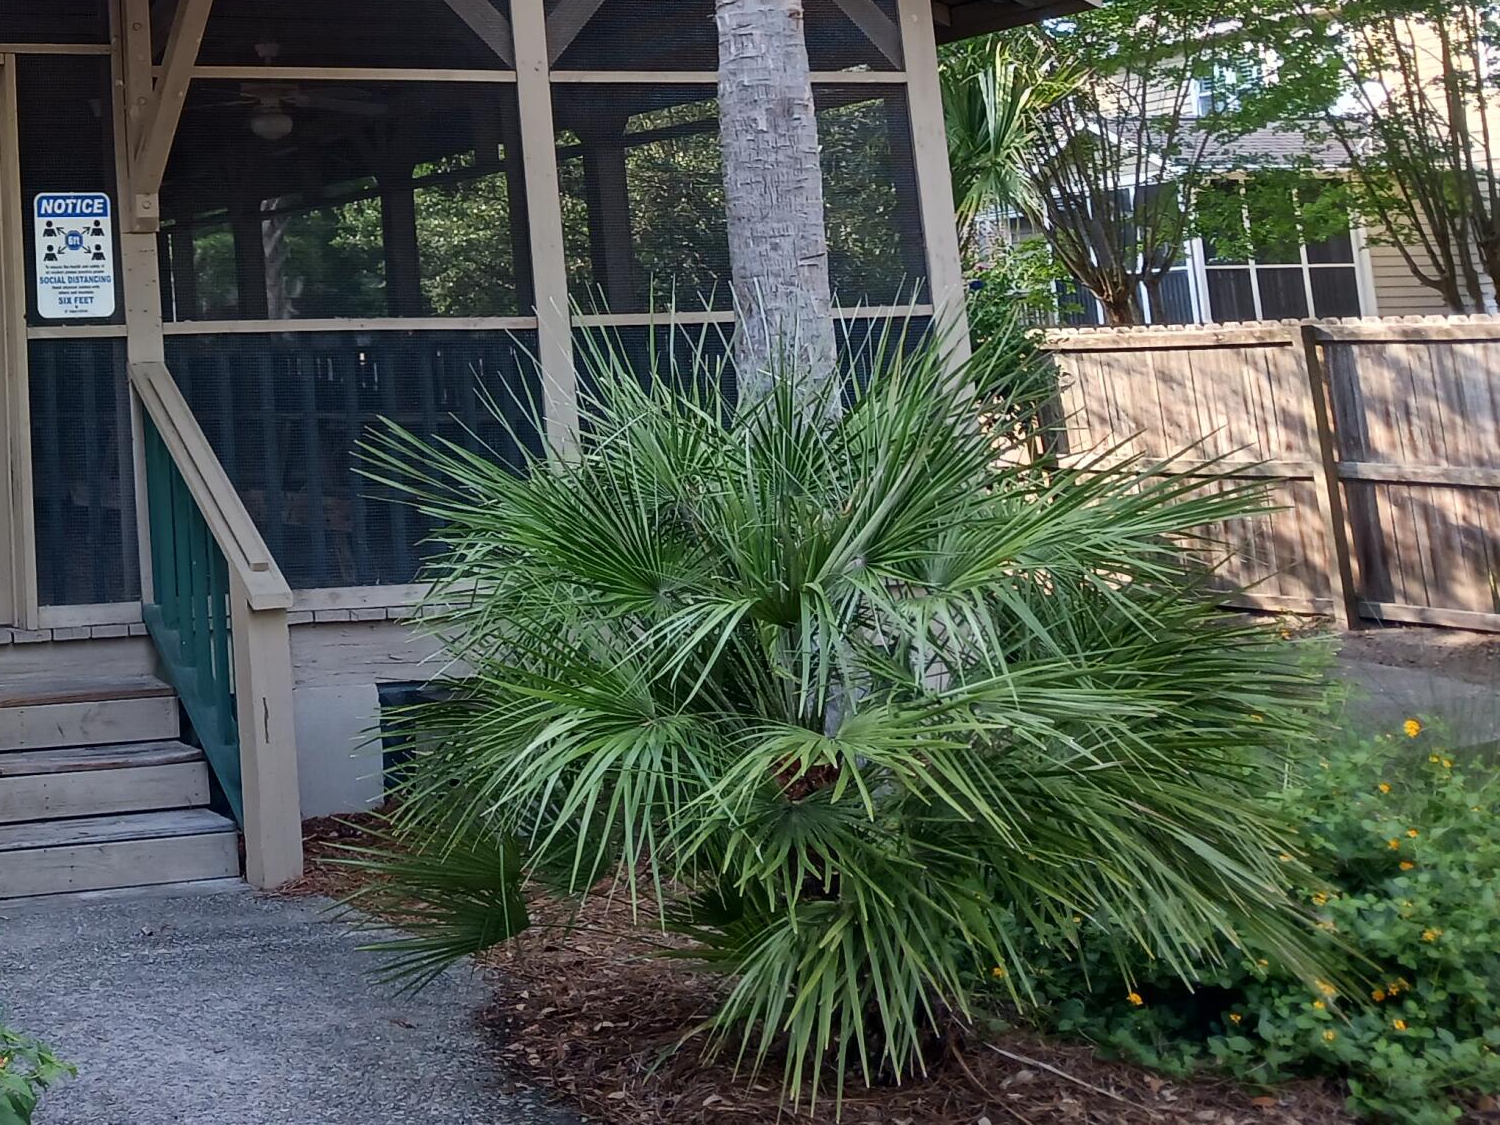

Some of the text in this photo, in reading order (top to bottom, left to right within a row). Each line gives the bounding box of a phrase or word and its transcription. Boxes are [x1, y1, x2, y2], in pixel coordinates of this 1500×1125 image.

[40, 198, 104, 215] NOTICE
[39, 275, 112, 284] SOCIAL DISTANCING
[58, 296, 94, 305] SIX FEET
